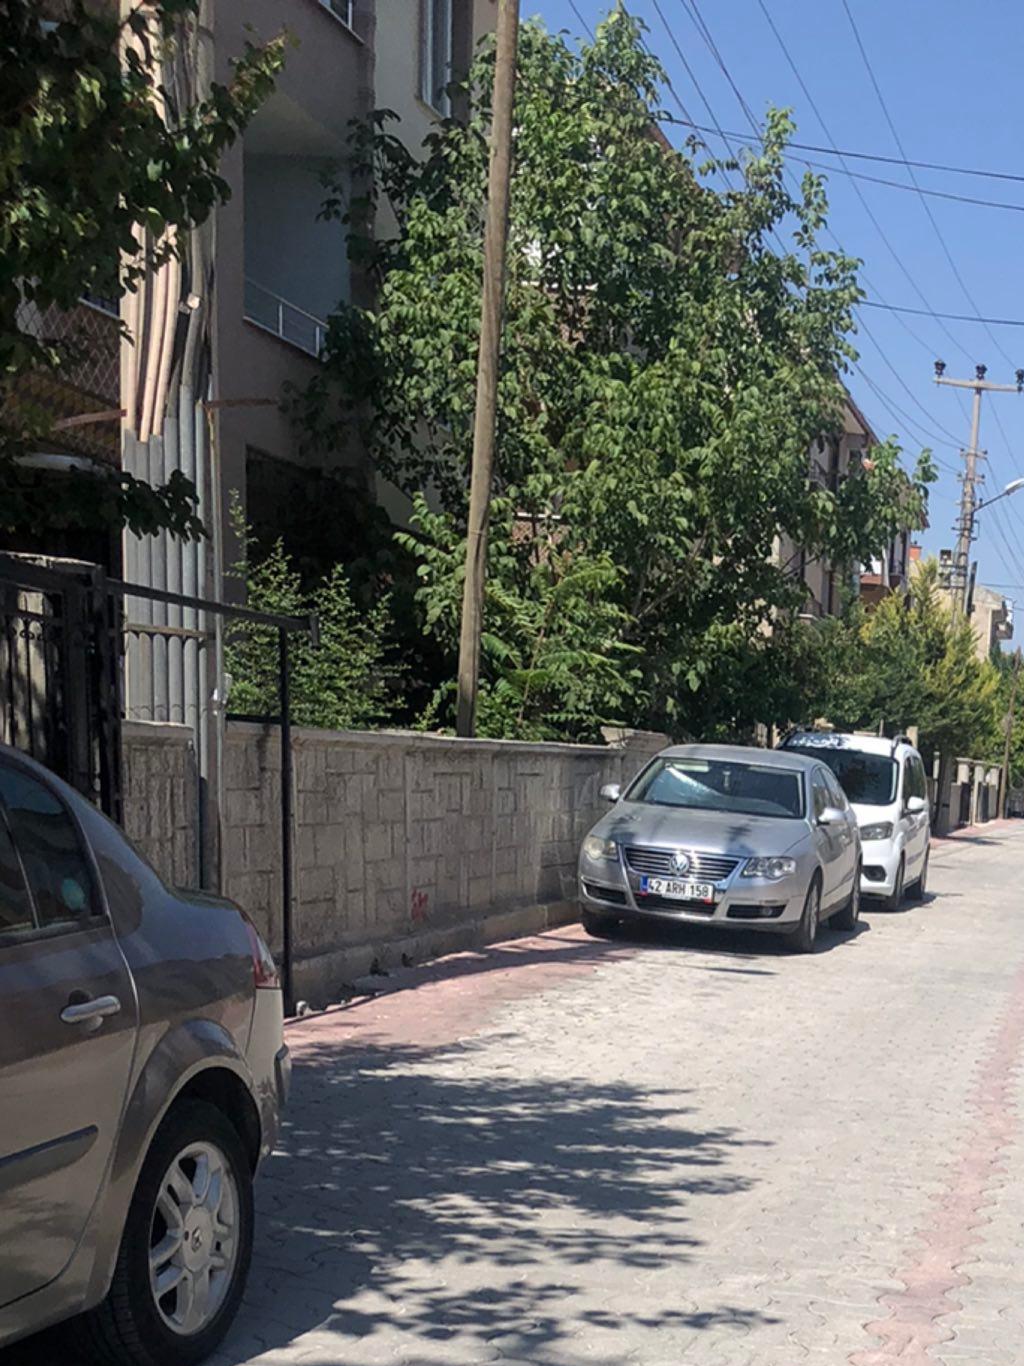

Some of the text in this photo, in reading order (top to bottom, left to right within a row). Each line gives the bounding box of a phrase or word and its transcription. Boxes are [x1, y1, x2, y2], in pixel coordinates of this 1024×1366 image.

[649, 880, 709, 897] 42 ARH 158
